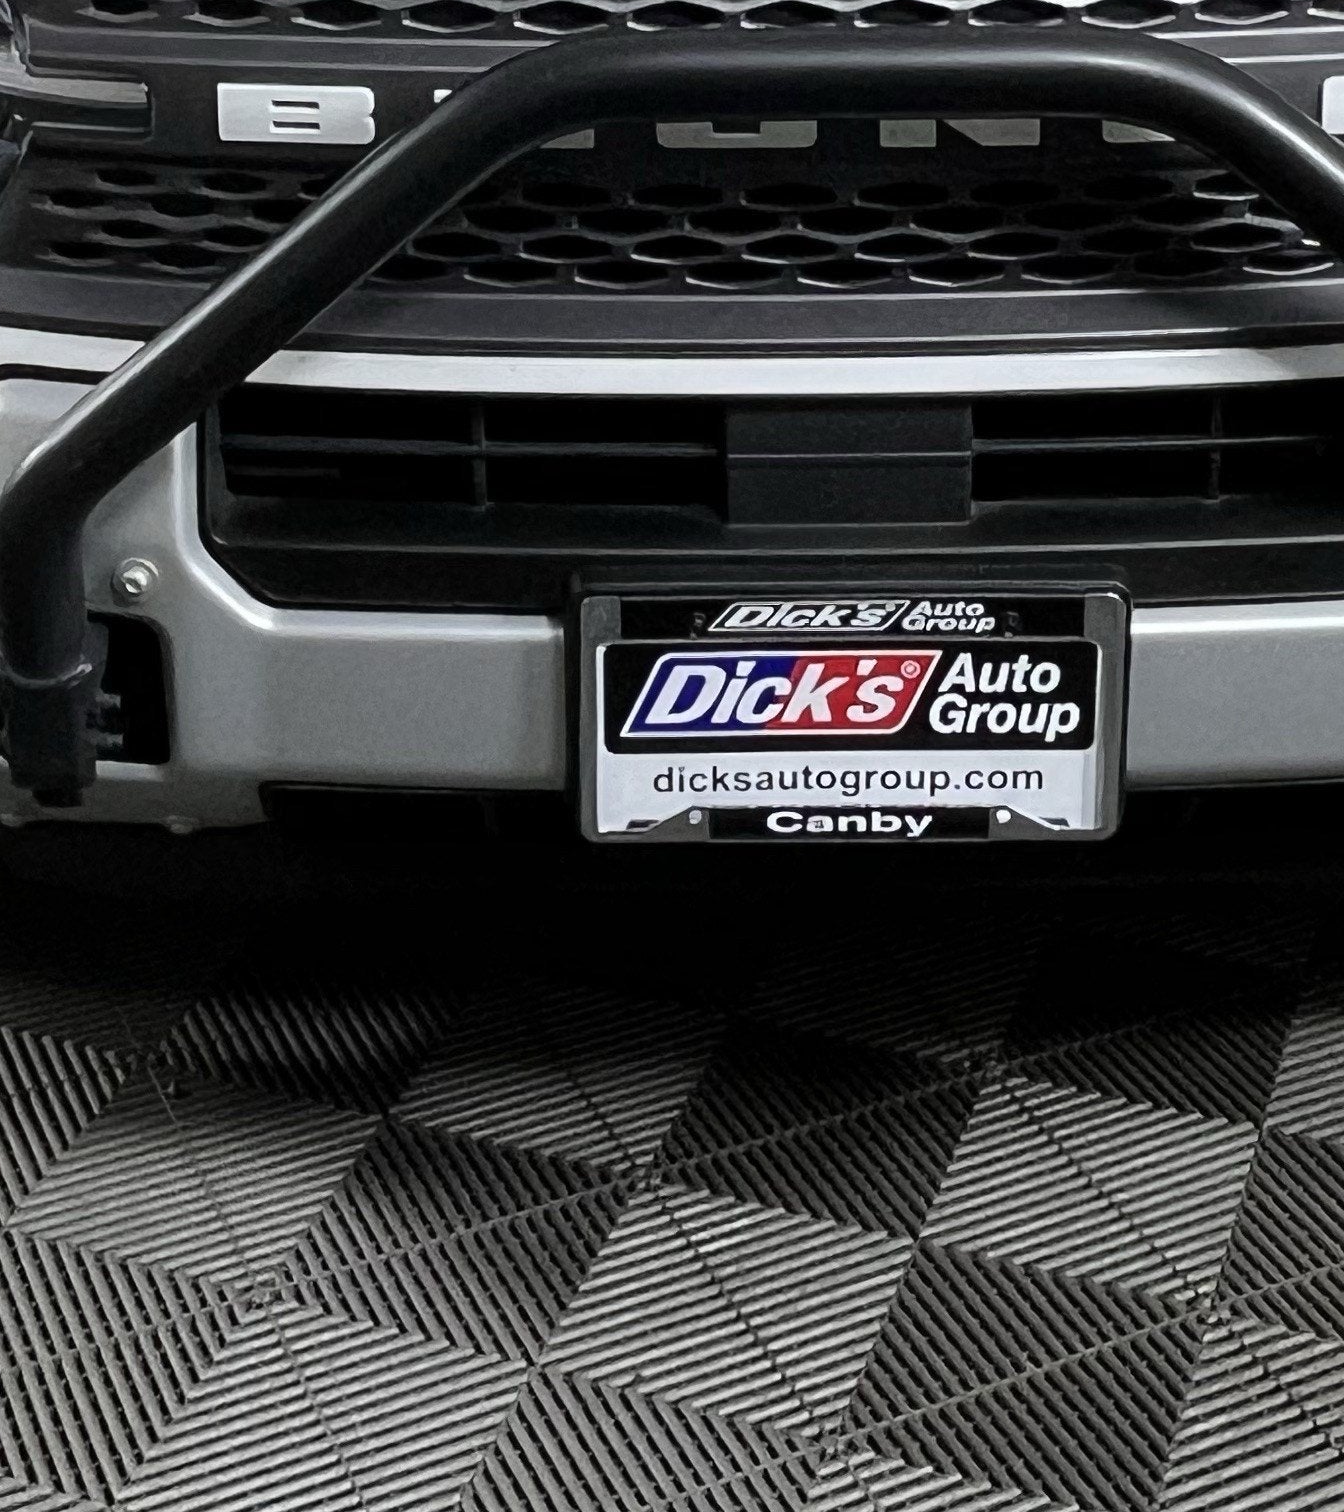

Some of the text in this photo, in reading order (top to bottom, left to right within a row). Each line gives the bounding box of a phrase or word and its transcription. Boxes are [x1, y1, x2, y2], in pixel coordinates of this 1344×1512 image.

[901, 614, 996, 634] Group
[910, 600, 985, 616] Auto
[938, 652, 1061, 693] Auto
[644, 658, 907, 725] Dick's
[929, 694, 1080, 742] Group
[653, 765, 1044, 797] dicksautogroup.com
[766, 810, 933, 838] Canby
